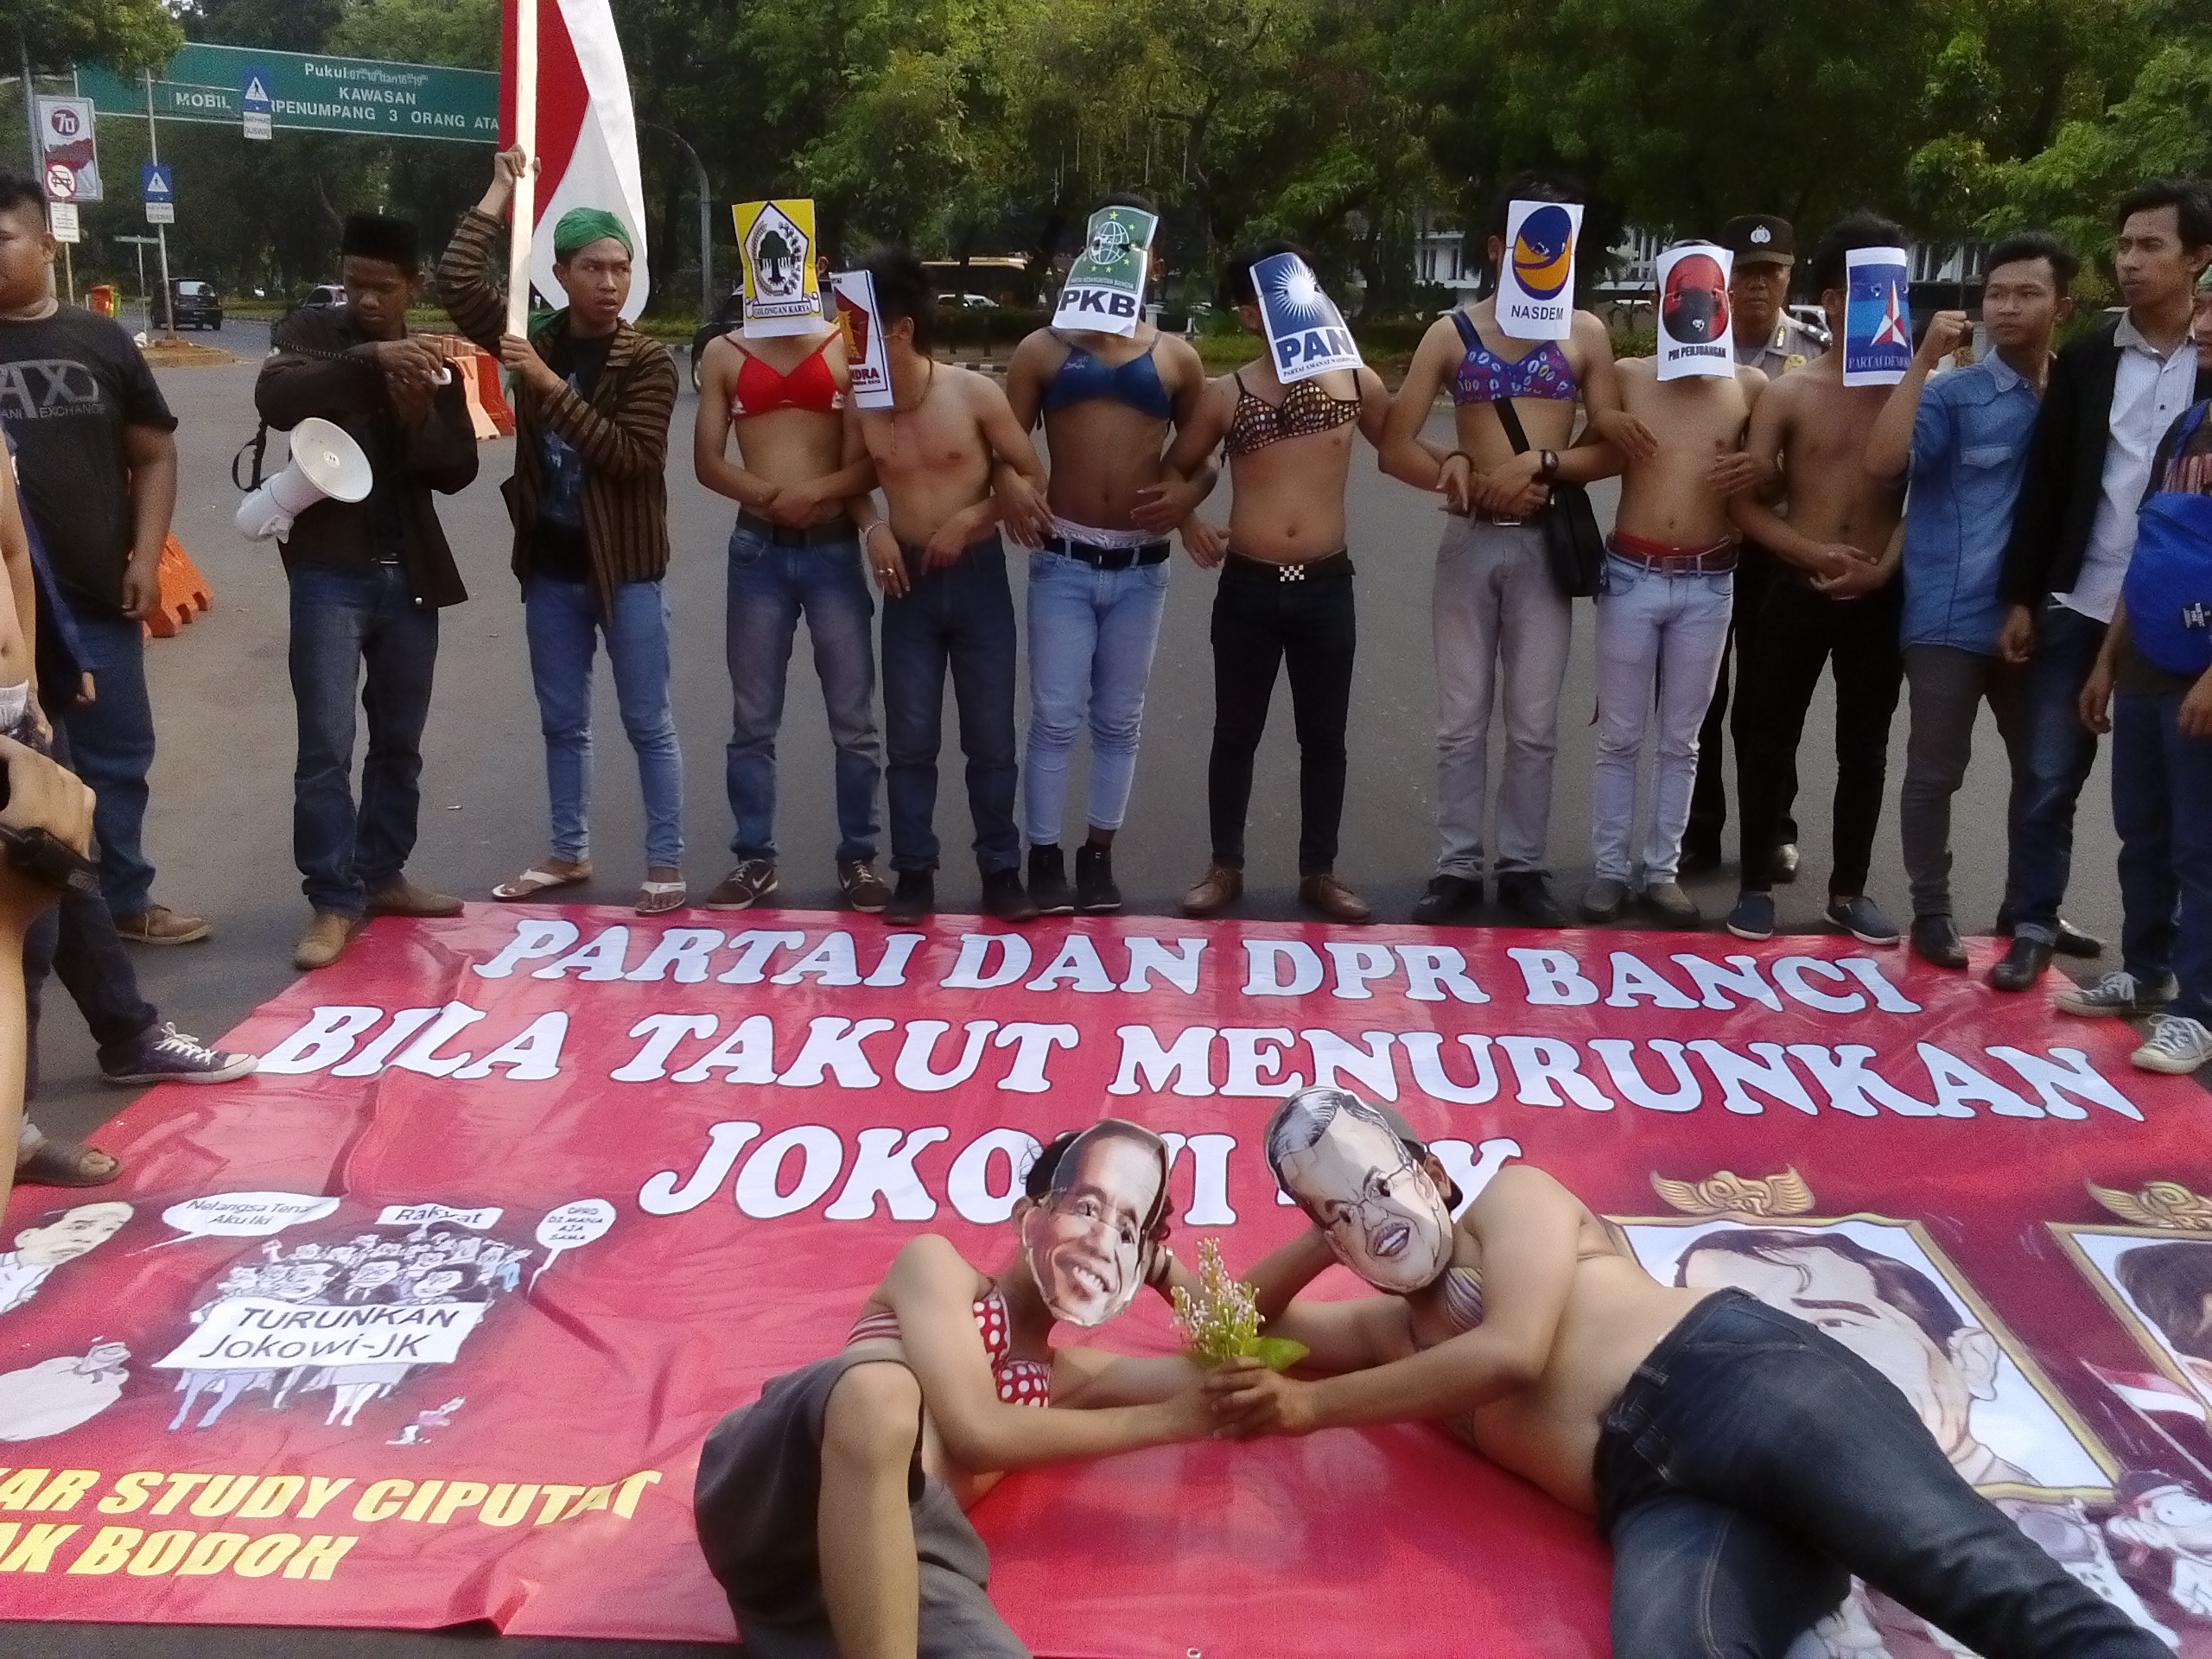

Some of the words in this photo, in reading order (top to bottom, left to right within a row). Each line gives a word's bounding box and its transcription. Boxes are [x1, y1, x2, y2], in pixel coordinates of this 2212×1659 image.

[339, 86, 416, 105] KAWASAN
[175, 92, 232, 109] MOBIL
[271, 99, 376, 120] PENUMPANG
[389, 109, 398, 123] 3
[411, 111, 465, 128] ORANG
[474, 117, 499, 130] ATA
[1058, 289, 1136, 318] PKB
[1510, 304, 1564, 320] NASDEM
[1275, 328, 1355, 369] PAN
[1848, 355, 1883, 369] PARTAI
[473, 918, 927, 987] PARTAI
[938, 932, 1208, 995] DAN
[1241, 939, 1491, 1004] DPR
[1506, 947, 1923, 1014] BANCI
[254, 1000, 569, 1080] BILA
[608, 1013, 1079, 1094] TAKUT
[1106, 1024, 2145, 1122] MENURUNKAN
[639, 1120, 1238, 1225] JOKOI
[207, 1214, 246, 1224] Aku
[270, 1202, 321, 1213] Tena
[395, 1205, 485, 1224] Rakyat
[238, 1306, 460, 1330] TURUNKAN
[199, 1332, 431, 1359] Jokowi-JK
[0, 1467, 101, 1511] AR
[97, 1471, 356, 1519] STUDY
[352, 1469, 664, 1527] CIPUTAT
[66, 1525, 360, 1580] BODOH
